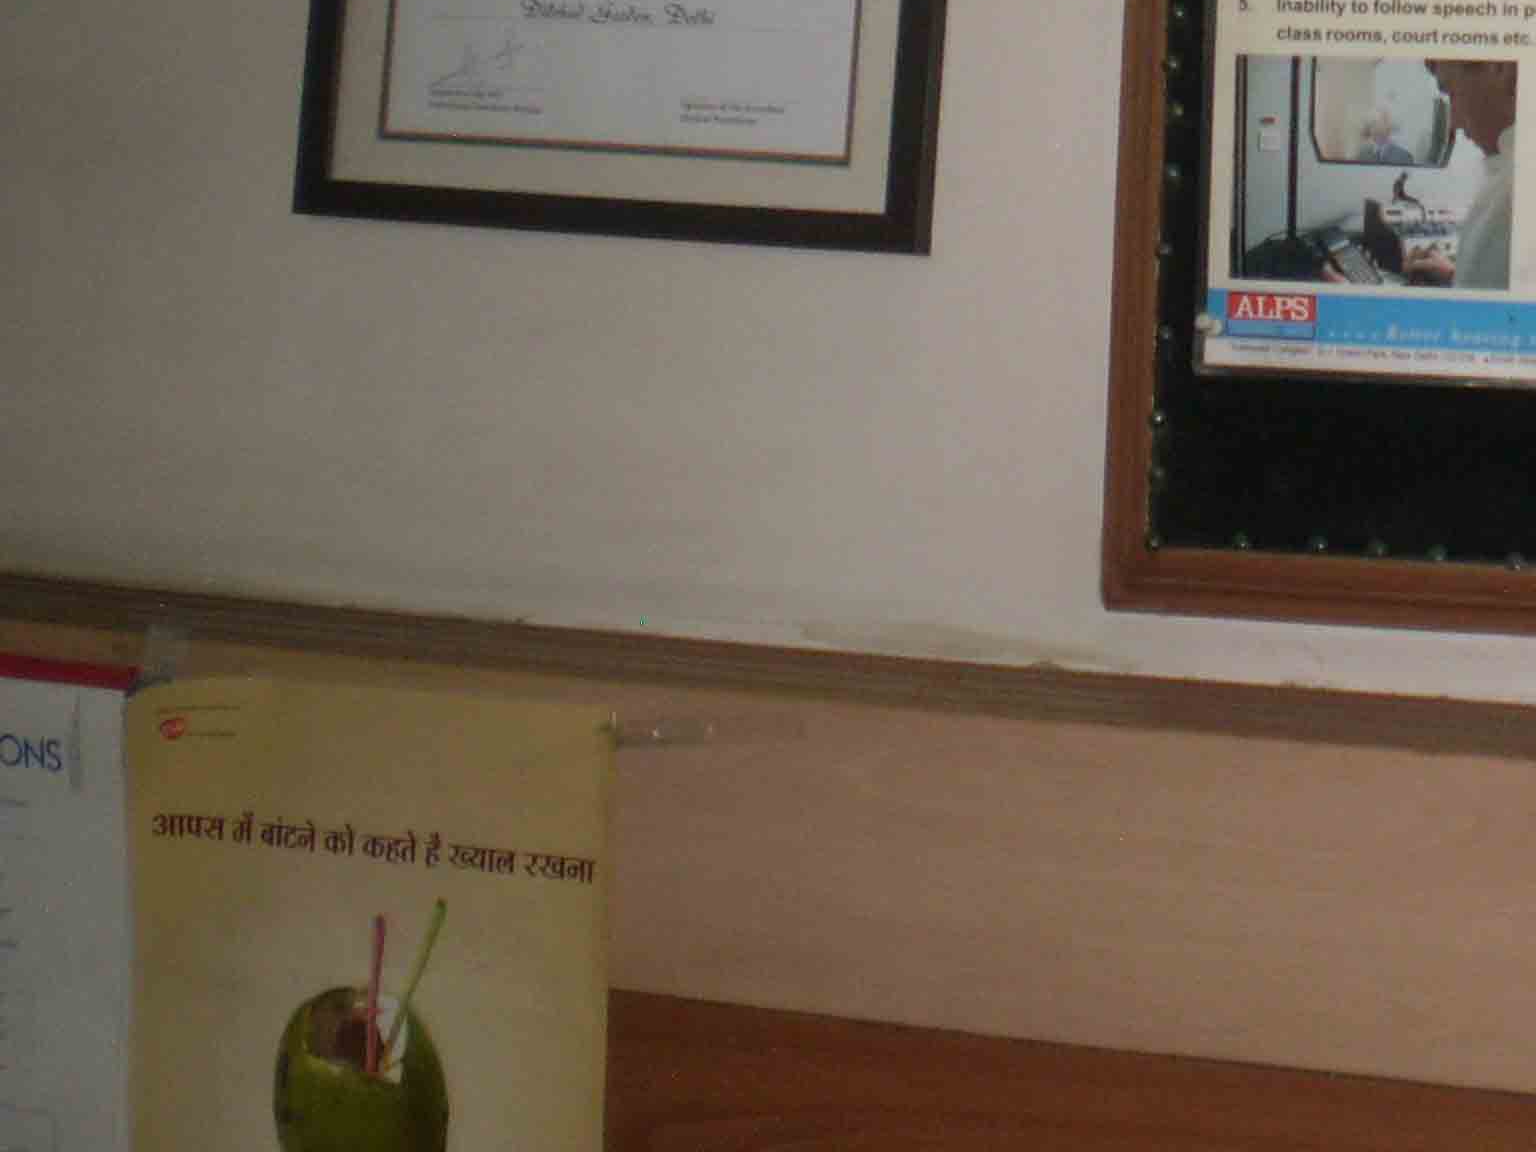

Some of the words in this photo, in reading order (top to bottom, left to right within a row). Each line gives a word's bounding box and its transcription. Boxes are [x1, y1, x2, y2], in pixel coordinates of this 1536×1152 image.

[1433, 0, 1496, 19] speech
[1502, 1, 1518, 16] in
[1277, 26, 1322, 42] class
[1326, 30, 1387, 45] rooms,
[1392, 30, 1438, 44] court
[1442, 32, 1498, 45] rooms
[1234, 296, 1309, 320] ALPS
[153, 814, 224, 840] आपस
[231, 811, 255, 845] में
[325, 825, 353, 856] को
[362, 830, 416, 864] कहते
[449, 844, 515, 875] ख्याल
[524, 853, 595, 884] रखना
